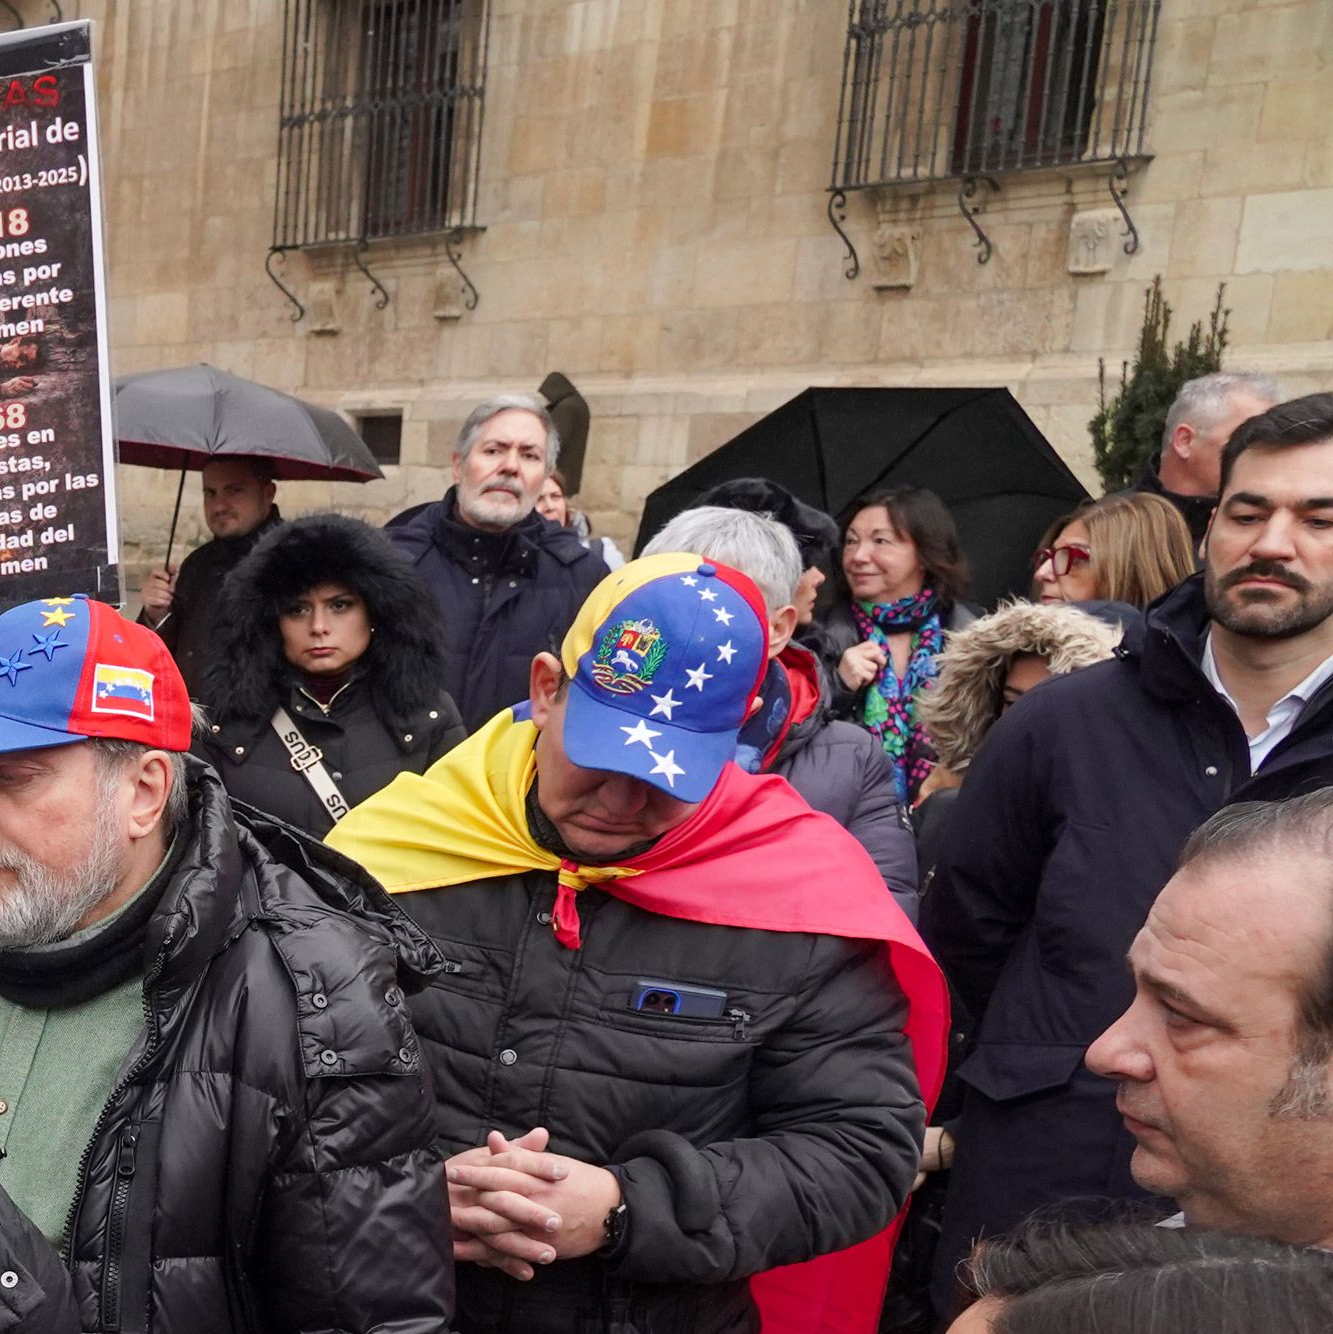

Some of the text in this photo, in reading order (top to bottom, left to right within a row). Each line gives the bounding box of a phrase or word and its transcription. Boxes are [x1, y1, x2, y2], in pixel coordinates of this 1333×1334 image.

[46, 117, 80, 143] de
[23, 260, 61, 289] por
[27, 428, 55, 444] en
[23, 477, 59, 501] por
[65, 470, 99, 491] las
[30, 503, 58, 522] de
[42, 525, 75, 545] del
